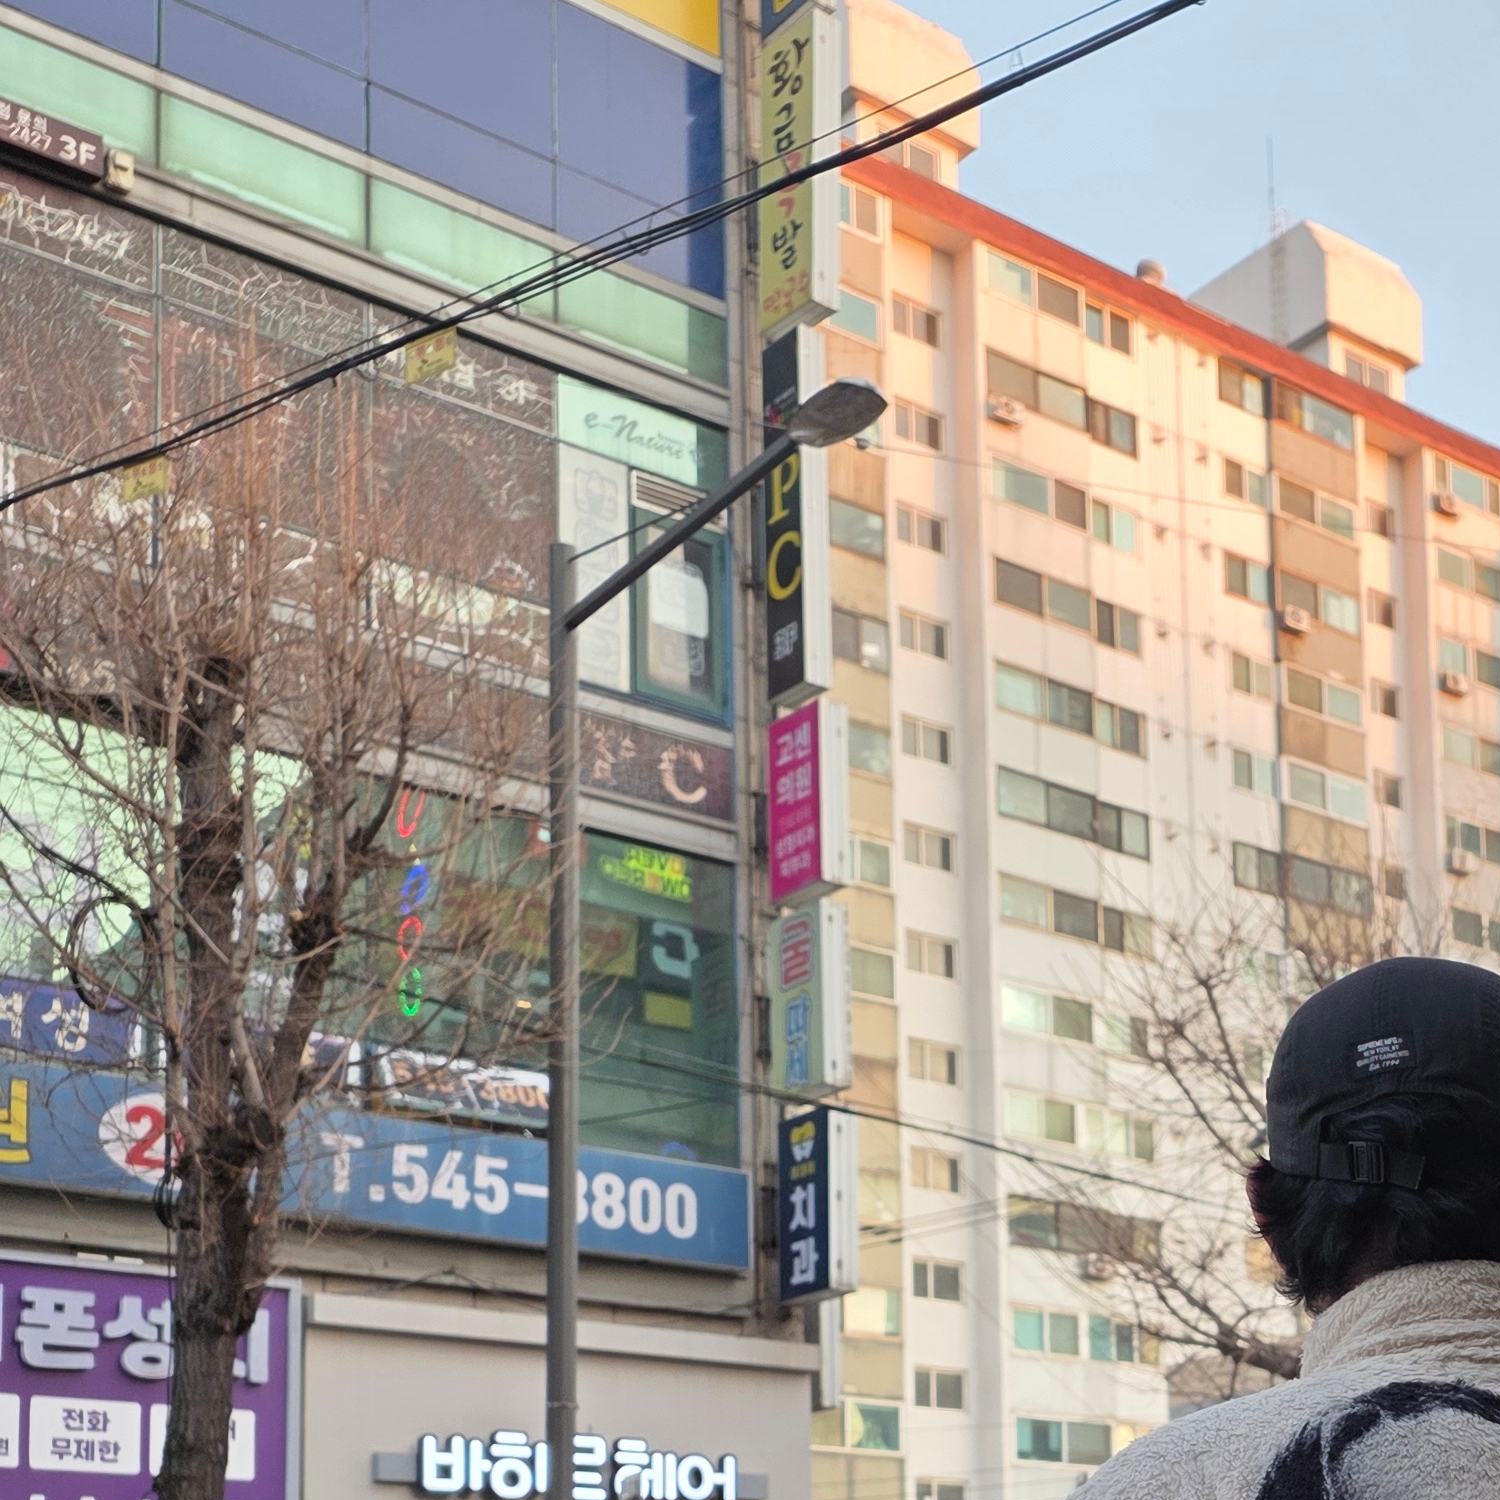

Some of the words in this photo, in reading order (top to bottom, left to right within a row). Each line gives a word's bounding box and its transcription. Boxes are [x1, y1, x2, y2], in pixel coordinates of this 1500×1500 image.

[59, 134, 97, 167] 3F
[789, 1182, 820, 1287] 치과
[62, 1406, 111, 1433] 전화
[51, 1438, 120, 1463] 무제한
